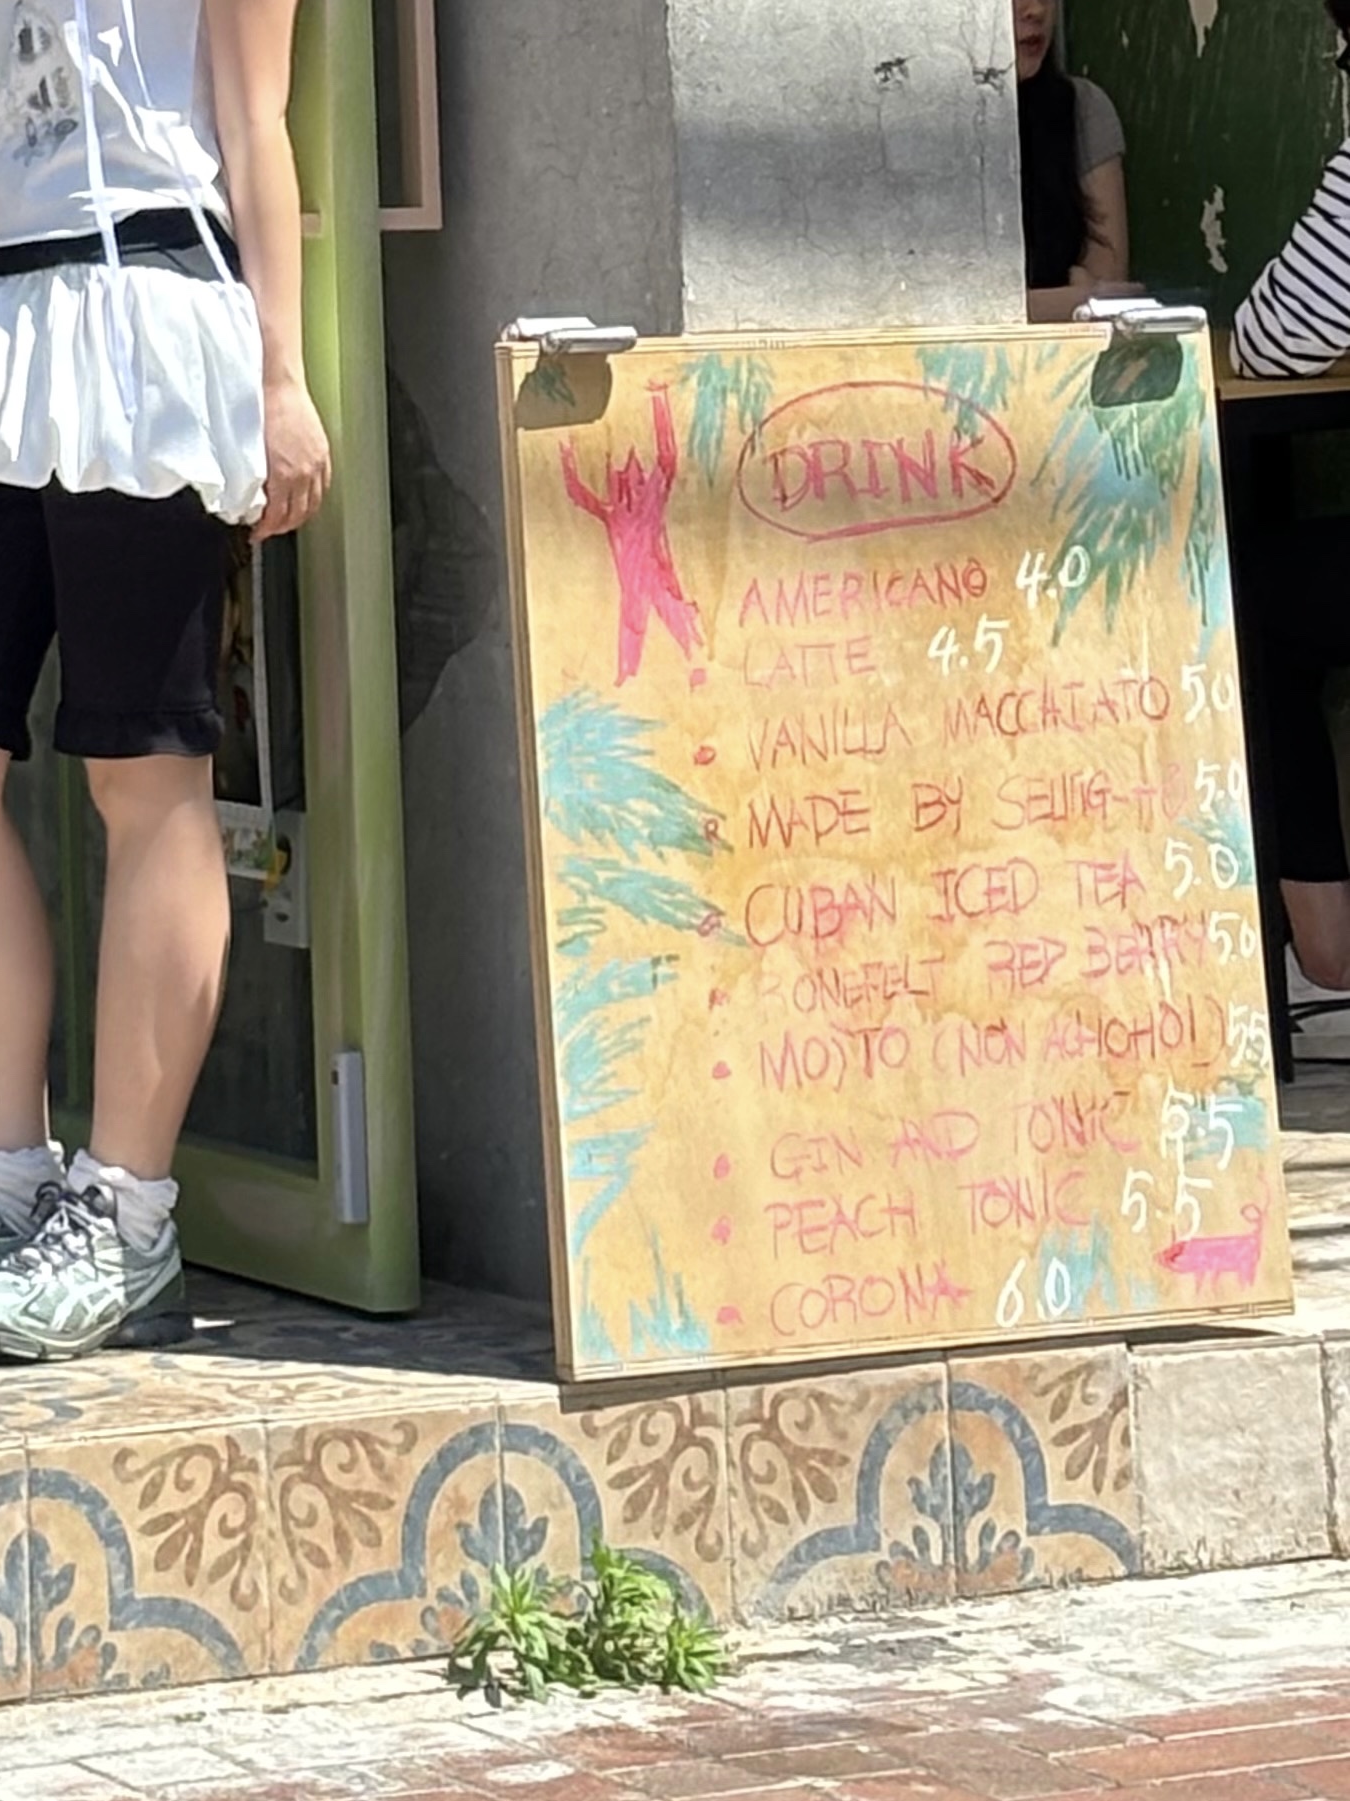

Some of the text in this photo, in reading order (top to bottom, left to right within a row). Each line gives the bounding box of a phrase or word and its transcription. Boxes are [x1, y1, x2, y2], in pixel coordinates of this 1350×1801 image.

[767, 428, 996, 511] DRINK
[739, 544, 1091, 629] AMERICANO 4.0
[743, 612, 1010, 688] LATTE 4.5
[748, 697, 911, 770] VANILLA
[748, 788, 871, 849] MADE
[910, 776, 964, 835] BY
[1194, 757, 1245, 813] 5.0
[745, 836, 1240, 950] CUBAN ICED TEA 5.0
[983, 935, 1068, 997] RED
[1207, 910, 1258, 967] 5.0
[770, 1084, 1243, 1181] GIN AND TONIC 5.5
[763, 1159, 1213, 1260] PEACH TONIC 5.5
[768, 1256, 1071, 1338] CORONA 6.0
